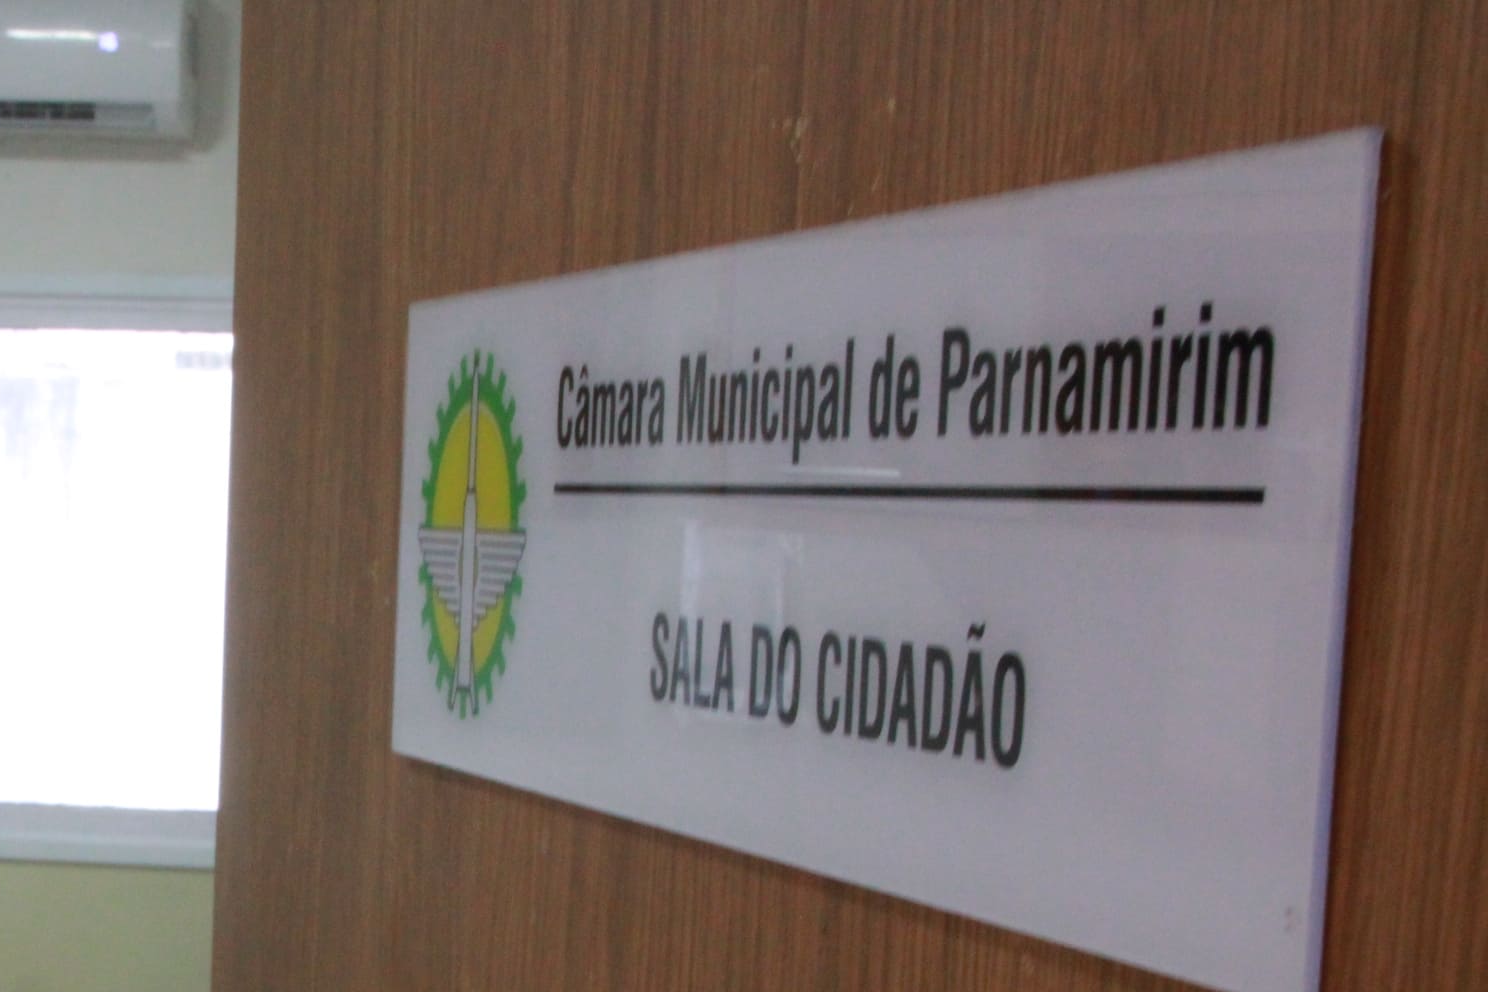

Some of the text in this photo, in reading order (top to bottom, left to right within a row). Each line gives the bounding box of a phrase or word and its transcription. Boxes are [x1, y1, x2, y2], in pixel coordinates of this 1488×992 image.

[557, 303, 1275, 463] Câmara Municipal de Parnamirim
[650, 614, 1025, 768] SALA DO CIDADÃO
